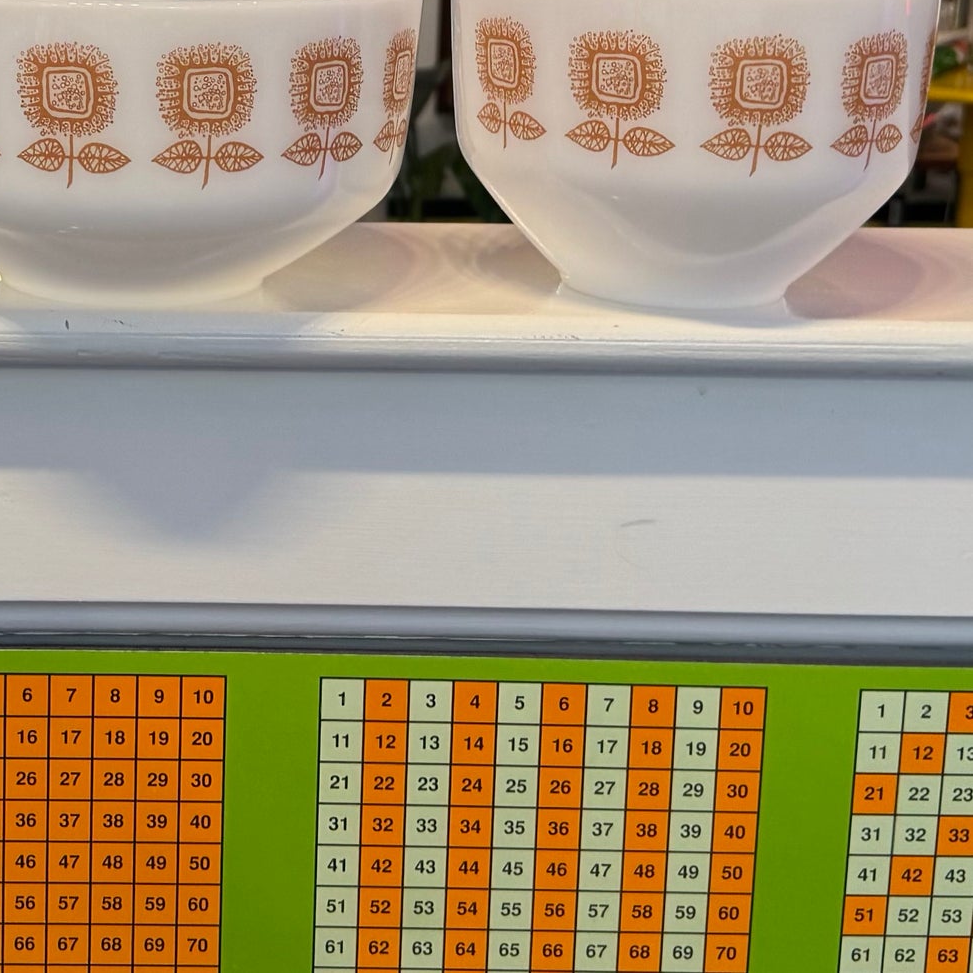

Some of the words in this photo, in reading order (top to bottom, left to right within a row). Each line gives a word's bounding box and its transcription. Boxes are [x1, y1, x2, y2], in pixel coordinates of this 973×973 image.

[23, 688, 32, 702] 6
[67, 688, 76, 702] 7
[111, 689, 120, 703] 8
[154, 689, 164, 703] 9
[194, 690, 213, 704] 10
[339, 692, 345, 706] 1
[382, 693, 391, 707] 2
[426, 694, 436, 708] 3
[470, 695, 480, 708] 4
[515, 696, 524, 710] 5
[559, 697, 569, 711] 6
[604, 698, 614, 712] 7
[648, 699, 658, 713] 8
[693, 700, 703, 714] 9
[734, 701, 753, 715] 10
[878, 704, 884, 717] 1
[921, 705, 931, 718] 2
[18, 730, 37, 744] 16
[62, 730, 81, 744] 17
[106, 731, 125, 745] 18
[149, 731, 169, 745] 19
[192, 732, 212, 745] 20
[332, 734, 348, 748] 11
[376, 735, 395, 748] 12
[420, 736, 439, 750] 13
[464, 737, 483, 750] 14
[509, 737, 528, 752] 15
[553, 739, 572, 753] 16
[598, 740, 617, 753] 17
[642, 741, 661, 755] 18
[687, 742, 706, 756] 19
[730, 743, 750, 757] 20
[869, 746, 886, 759] 11
[914, 746, 933, 760] 12
[16, 772, 36, 785] 26
[60, 772, 80, 785] 27
[104, 772, 124, 786] 28
[148, 773, 168, 787] 29
[191, 773, 211, 787] 30
[330, 775, 348, 789] 21
[374, 776, 394, 790] 22
[418, 777, 438, 791] 23
[462, 778, 482, 792] 24
[506, 779, 526, 793] 25
[550, 780, 571, 794] 26
[594, 781, 615, 795] 27
[639, 782, 659, 796] 28
[683, 783, 704, 797] 29
[727, 784, 748, 798] 30
[864, 787, 883, 800] 21
[908, 787, 930, 801] 22
[953, 788, 973, 802] 23
[16, 813, 36, 827] 36
[60, 813, 80, 827] 37
[103, 814, 123, 828] 38
[147, 814, 167, 828] 39
[190, 815, 211, 829] 40
[329, 817, 347, 831] 31
[373, 818, 393, 831] 32
[417, 819, 437, 833] 33
[460, 820, 480, 833] 34
[504, 820, 525, 834] 35
[548, 822, 569, 835] 36
[592, 822, 613, 836] 37
[637, 824, 657, 837] 38
[681, 824, 701, 838] 39
[725, 825, 745, 839] 40
[861, 828, 880, 841] 31
[905, 828, 926, 842] 32
[949, 829, 969, 842] 33
[15, 855, 36, 868] 46
[59, 855, 79, 868] 47
[102, 855, 123, 869] 48
[146, 856, 166, 869] 49
[190, 856, 210, 870] 50
[328, 858, 345, 872] 41
[371, 859, 391, 873] 42
[415, 860, 435, 874] 43
[459, 861, 479, 874] 44
[502, 862, 523, 875] 45
[546, 863, 567, 876] 46
[590, 864, 611, 877] 47
[634, 864, 654, 878] 48
[678, 865, 699, 879] 49
[722, 866, 742, 880] 50
[858, 868, 876, 881] 41
[902, 869, 922, 882] 42
[945, 869, 965, 883] 43
[15, 896, 35, 909] 56
[59, 896, 79, 910] 57
[102, 897, 122, 910] 58
[145, 897, 165, 911] 59
[188, 897, 208, 911] 60
[327, 899, 344, 913] 51
[370, 900, 390, 913] 52
[414, 901, 434, 915] 53
[457, 902, 477, 915] 54
[501, 903, 521, 916] 55
[545, 903, 564, 917] 56
[588, 904, 609, 918] 57
[632, 905, 652, 918] 58
[675, 906, 696, 919] 59
[719, 906, 739, 920] 60
[855, 908, 873, 921] 51
[898, 909, 919, 922] 52
[942, 910, 962, 923] 53
[852, 948, 869, 962] 61
[895, 949, 915, 962] 62
[938, 949, 958, 962] 63
